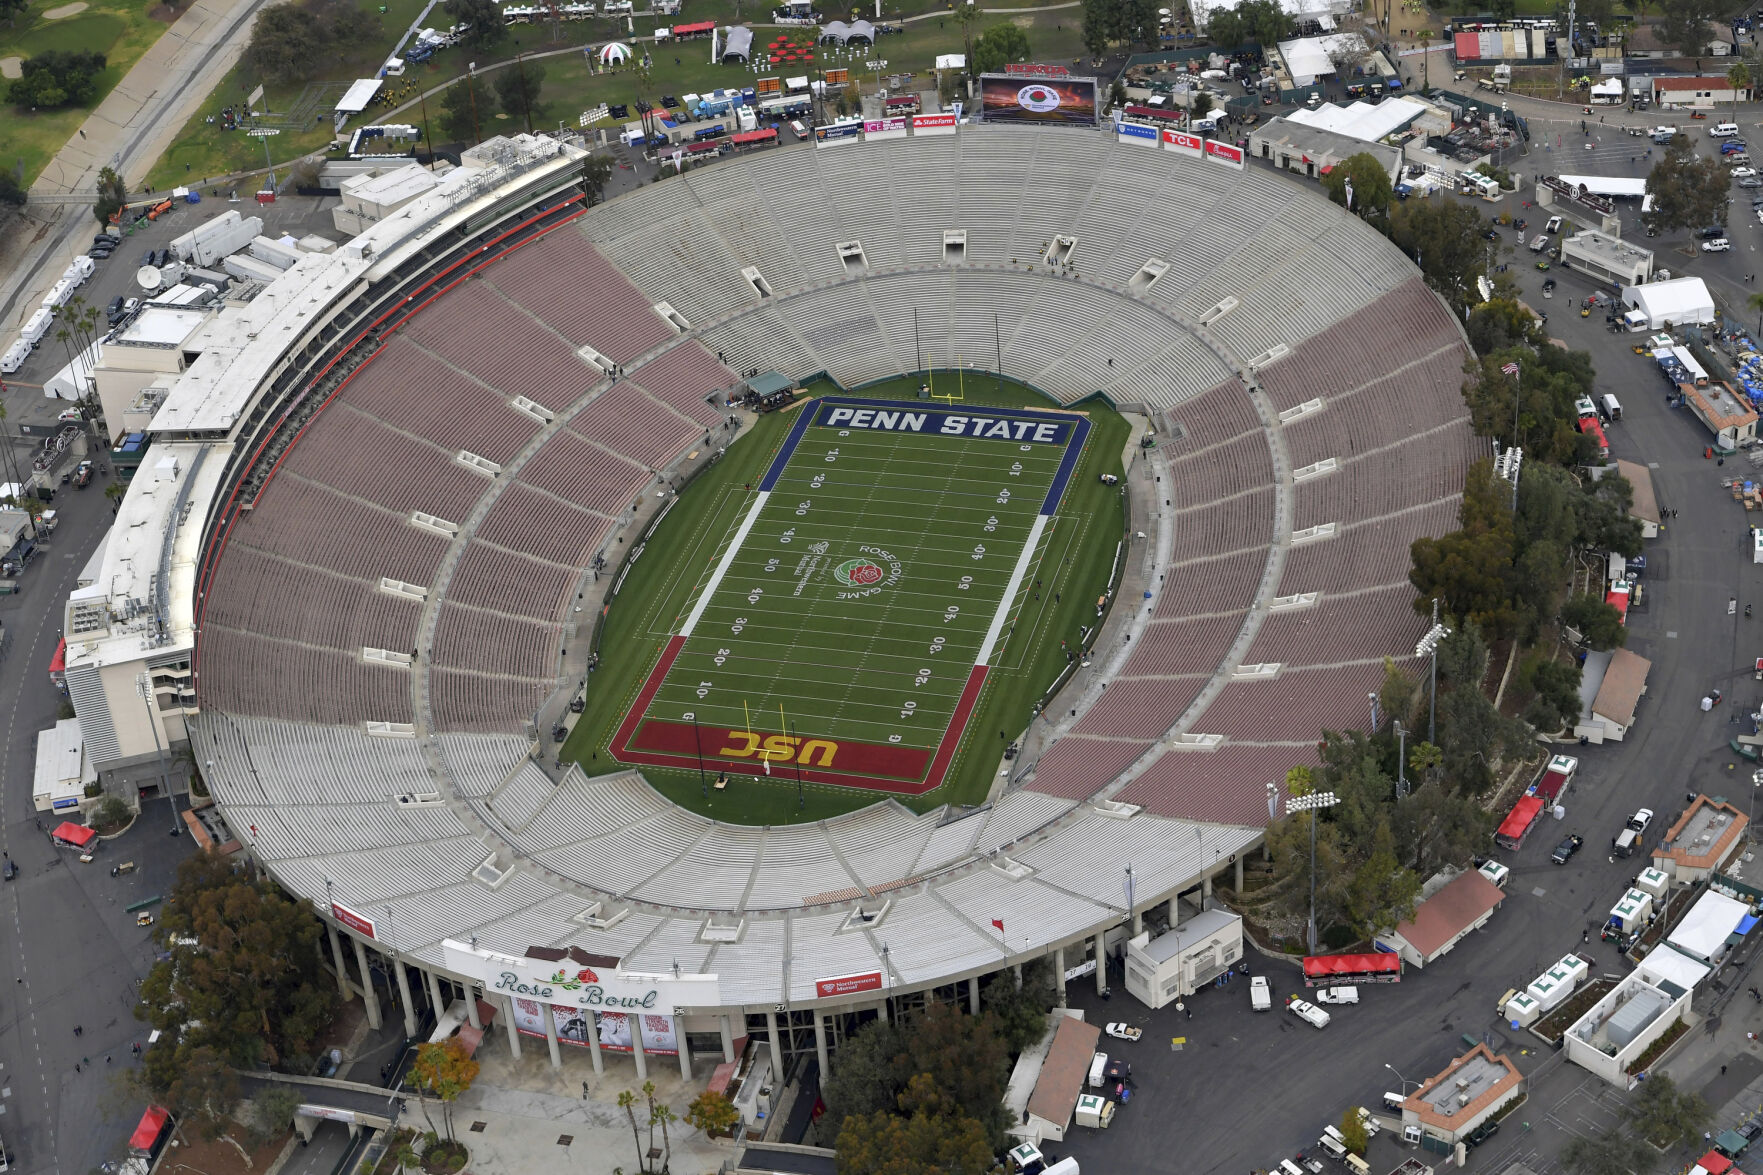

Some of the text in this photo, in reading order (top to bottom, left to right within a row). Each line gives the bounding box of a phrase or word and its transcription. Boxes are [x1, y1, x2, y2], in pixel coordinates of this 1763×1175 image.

[1005, 64, 1070, 75] HONDA
[1169, 134, 1194, 147] TCL
[827, 407, 1059, 442] PENN STATE
[825, 450, 839, 462] 10
[1009, 464, 1023, 476] 10
[810, 475, 825, 488] 20
[996, 491, 1011, 504] 20
[795, 502, 810, 515] 30
[983, 518, 998, 532] 30
[780, 530, 794, 543] 40
[971, 546, 986, 560] 40
[764, 558, 780, 572] 50
[859, 545, 902, 587] ROSE BOWL
[957, 575, 973, 590] 50
[747, 587, 763, 602] 40
[835, 587, 882, 599] GAME
[944, 605, 960, 620] 40
[731, 617, 748, 632] 30
[929, 636, 946, 651] 30
[713, 648, 731, 663] 20
[915, 668, 931, 684] 20
[696, 681, 713, 695] 10
[900, 701, 917, 716] 10
[719, 730, 839, 767] USC
[836, 977, 876, 988] Northwestern
[836, 984, 858, 992] Mutual
[495, 971, 658, 1009] Rose Bowl
